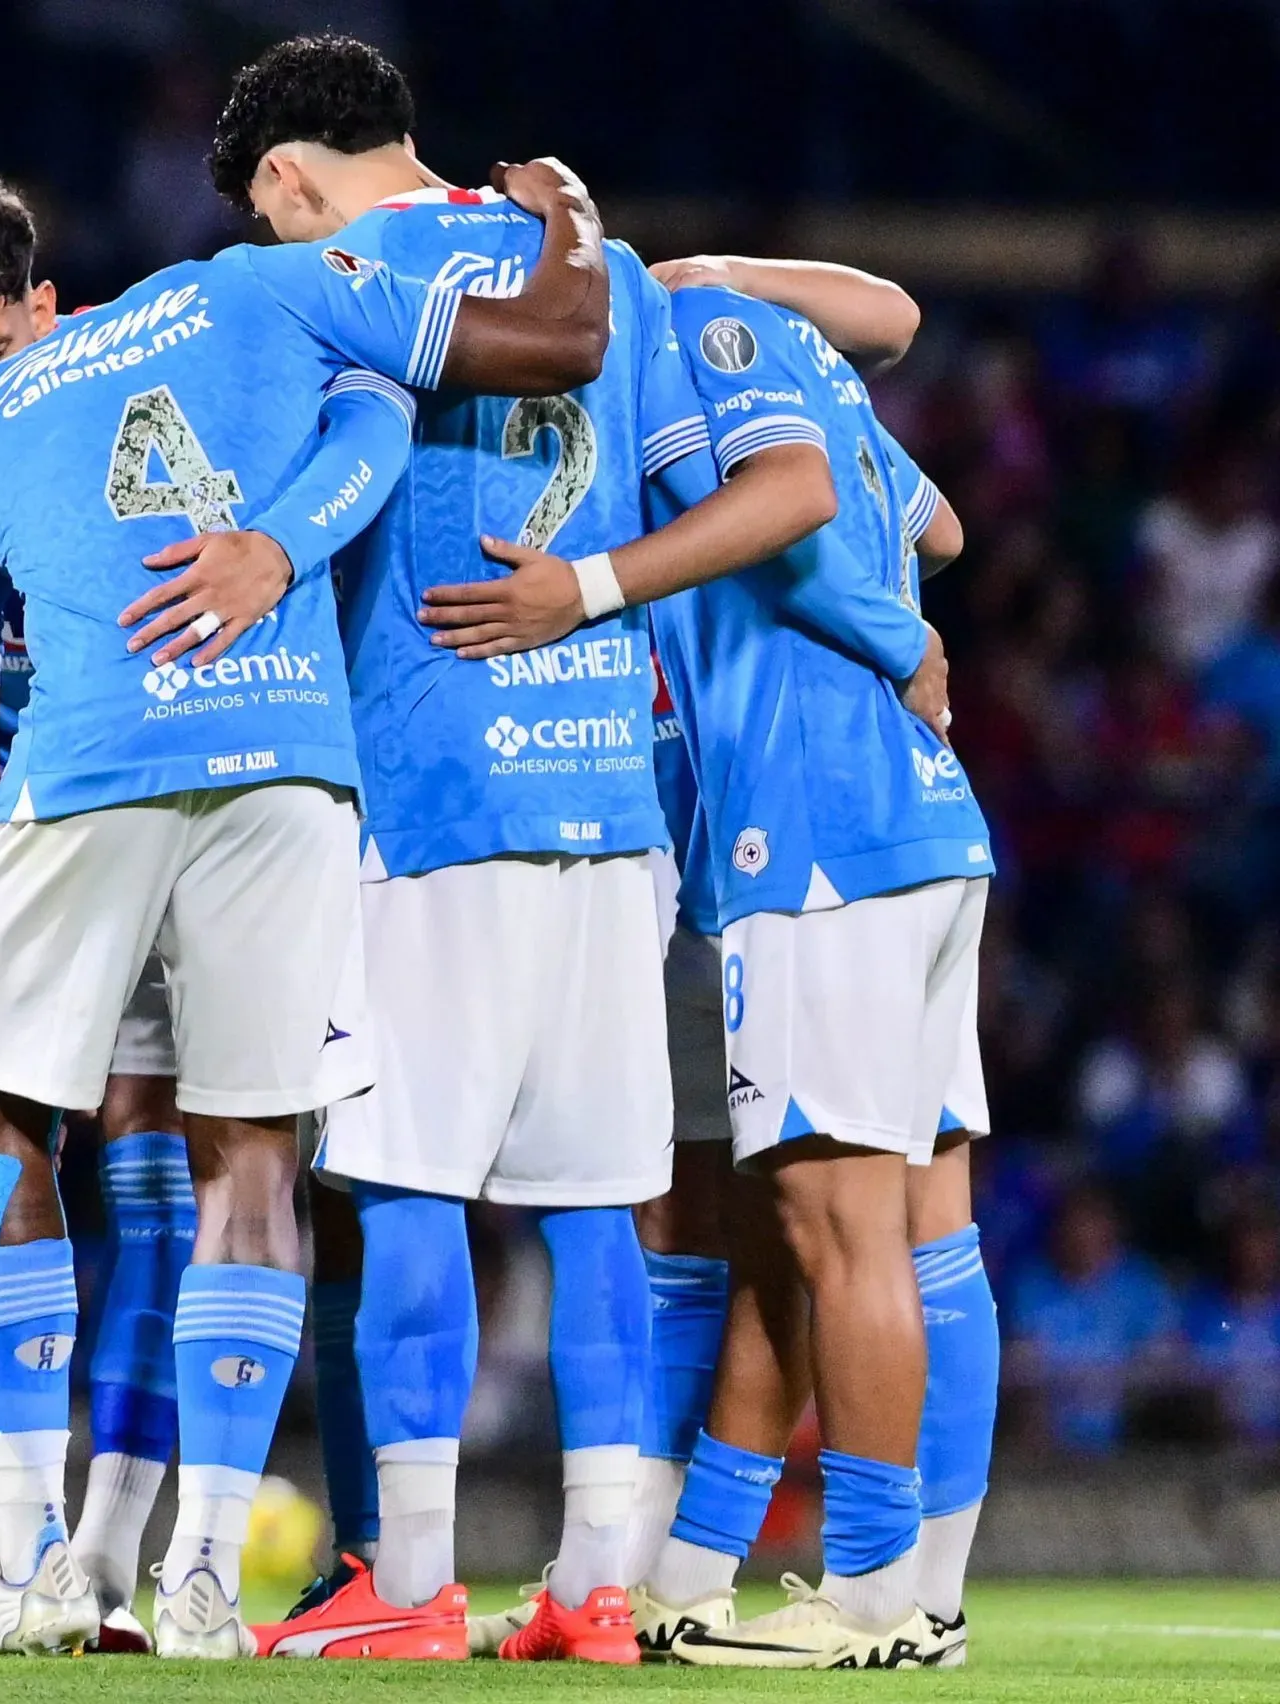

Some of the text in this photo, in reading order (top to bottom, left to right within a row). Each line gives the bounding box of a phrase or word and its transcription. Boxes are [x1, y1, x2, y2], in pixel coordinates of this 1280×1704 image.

[437, 212, 529, 229] PIRMA
[433, 250, 526, 299] Cali
[2, 309, 214, 418] caliente.mx
[104, 383, 244, 534] 4
[308, 458, 373, 527] PIRMA
[193, 646, 318, 688] cemix
[142, 688, 330, 722] ADHESIVOS Y ESTUCOS
[532, 708, 633, 750] cemix
[207, 750, 280, 776] CRUZ AZUL
[489, 755, 647, 776] ADHESIVOS Y ESTUCOS
[728, 1087, 766, 1111] RMA
